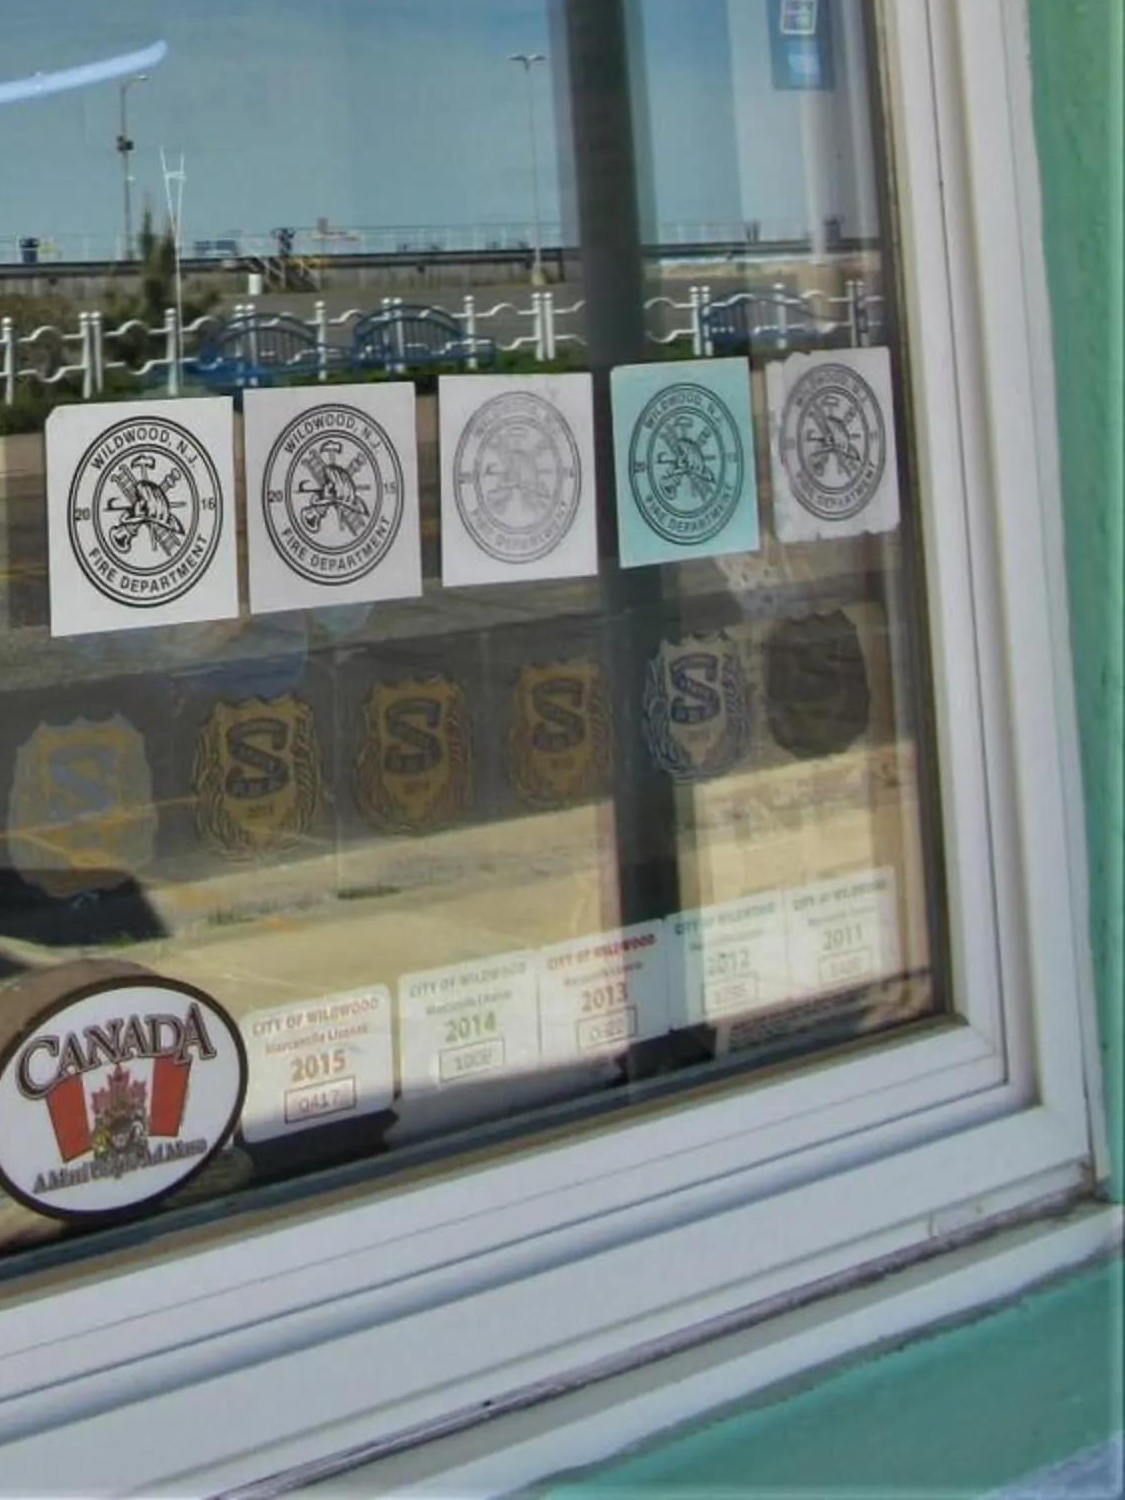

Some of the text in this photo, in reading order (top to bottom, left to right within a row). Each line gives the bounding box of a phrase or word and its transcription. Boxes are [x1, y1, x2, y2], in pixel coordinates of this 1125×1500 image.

[91, 427, 173, 470] WILDWOOD,
[74, 507, 90, 521] 20
[281, 515, 391, 571] FIRE DEPARTMENT
[89, 534, 208, 593] FIRE DEPARTMENT
[822, 922, 864, 952] 2011
[409, 978, 437, 998] CITY
[438, 975, 456, 993] OF
[581, 982, 630, 1014] 2013
[252, 996, 380, 1036] CITY OF WILDWOOD
[444, 1009, 497, 1044] 2014
[15, 1002, 217, 1100] CANADA
[289, 1048, 347, 1084] 2015
